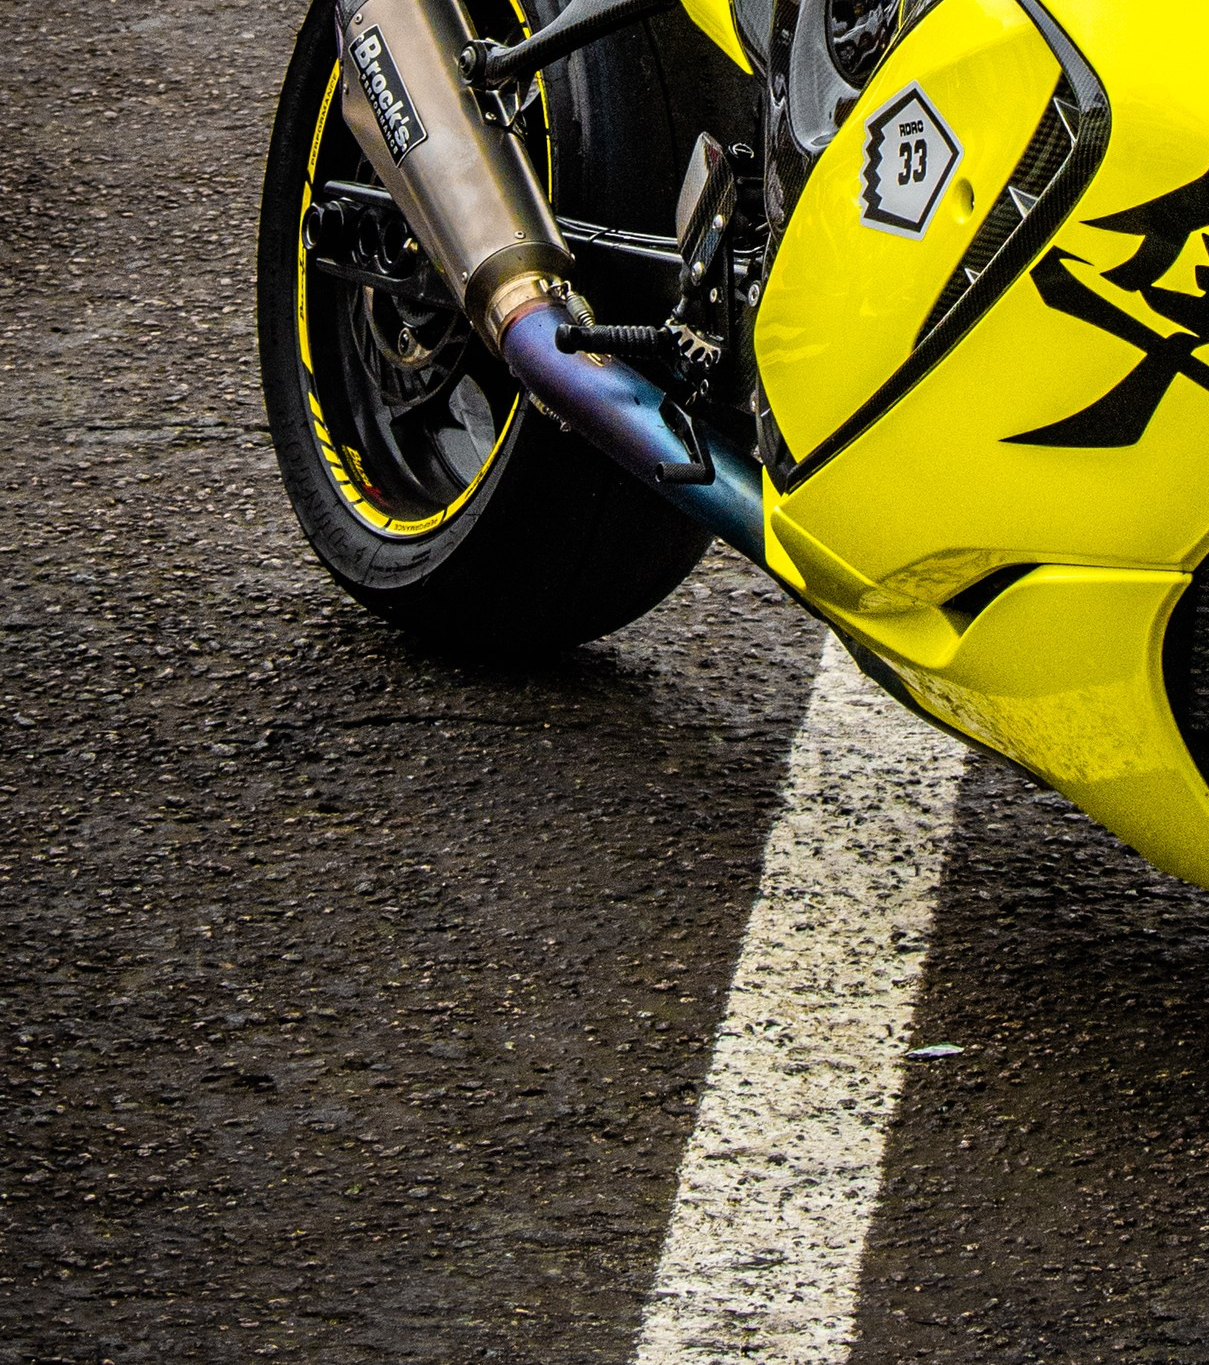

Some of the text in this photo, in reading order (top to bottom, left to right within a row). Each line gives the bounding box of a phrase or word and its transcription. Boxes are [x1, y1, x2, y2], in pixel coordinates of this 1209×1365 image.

[309, 72, 338, 168] PERFORMANCE
[353, 34, 411, 148] Brock's
[361, 72, 399, 156] PERFORMANCE
[898, 119, 924, 137] RDRC
[897, 138, 928, 186] 33
